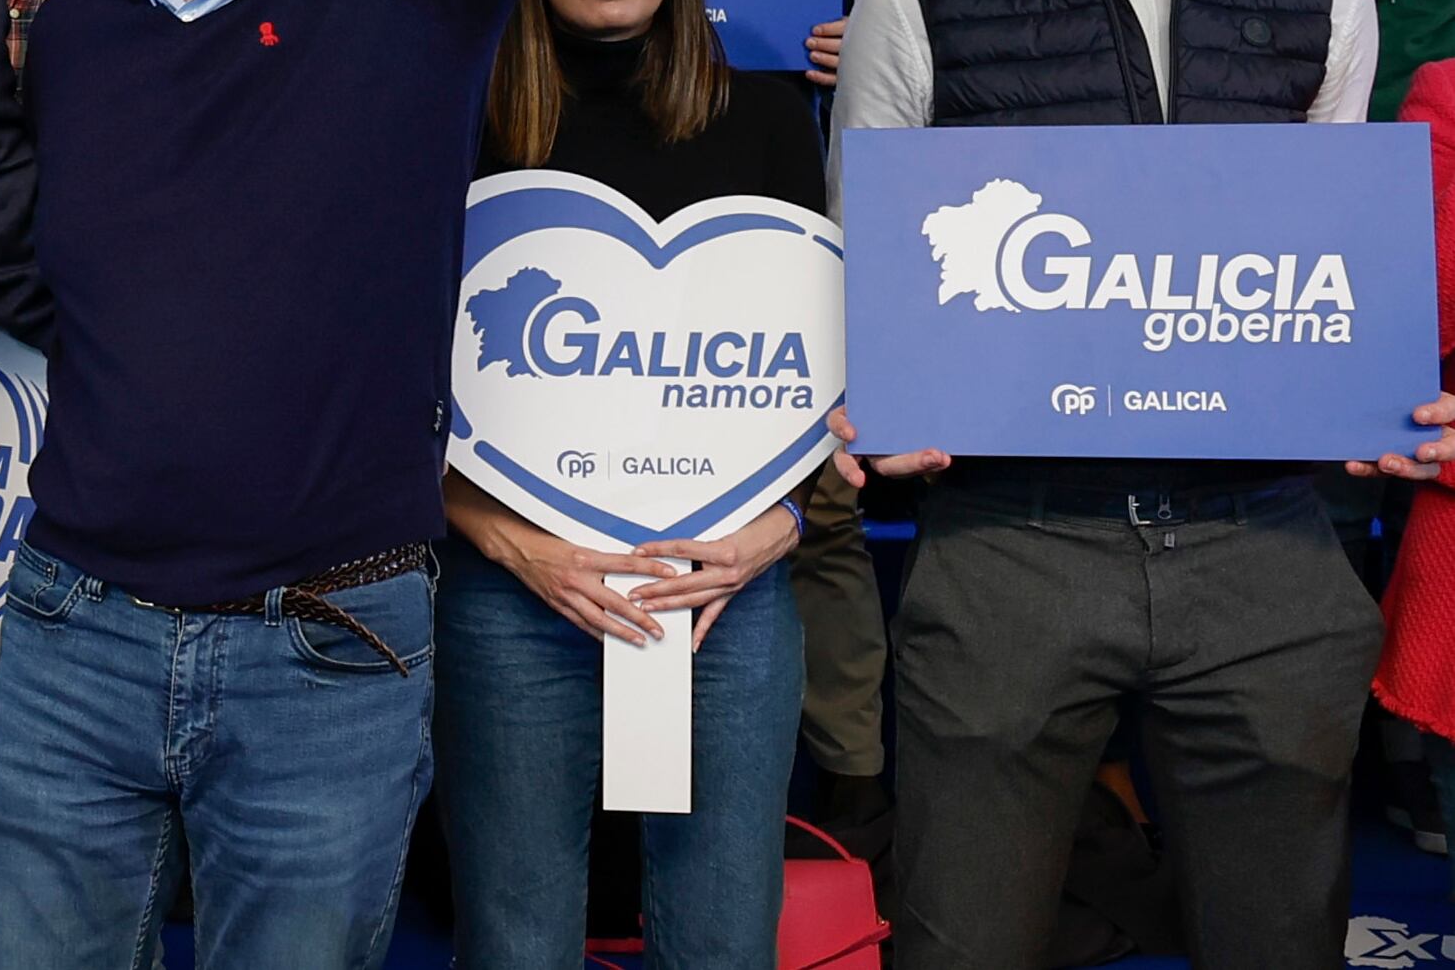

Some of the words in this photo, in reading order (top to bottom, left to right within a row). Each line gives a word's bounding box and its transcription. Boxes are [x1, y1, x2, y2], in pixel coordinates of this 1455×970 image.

[1000, 213, 1355, 311] GALICIA
[528, 296, 811, 379] GALICIA
[1143, 303, 1352, 352] goberna
[661, 383, 814, 410] namora
[1123, 390, 1227, 412] GALICIA
[622, 456, 715, 476] GALICIA
[1373, 932, 1455, 961] X
